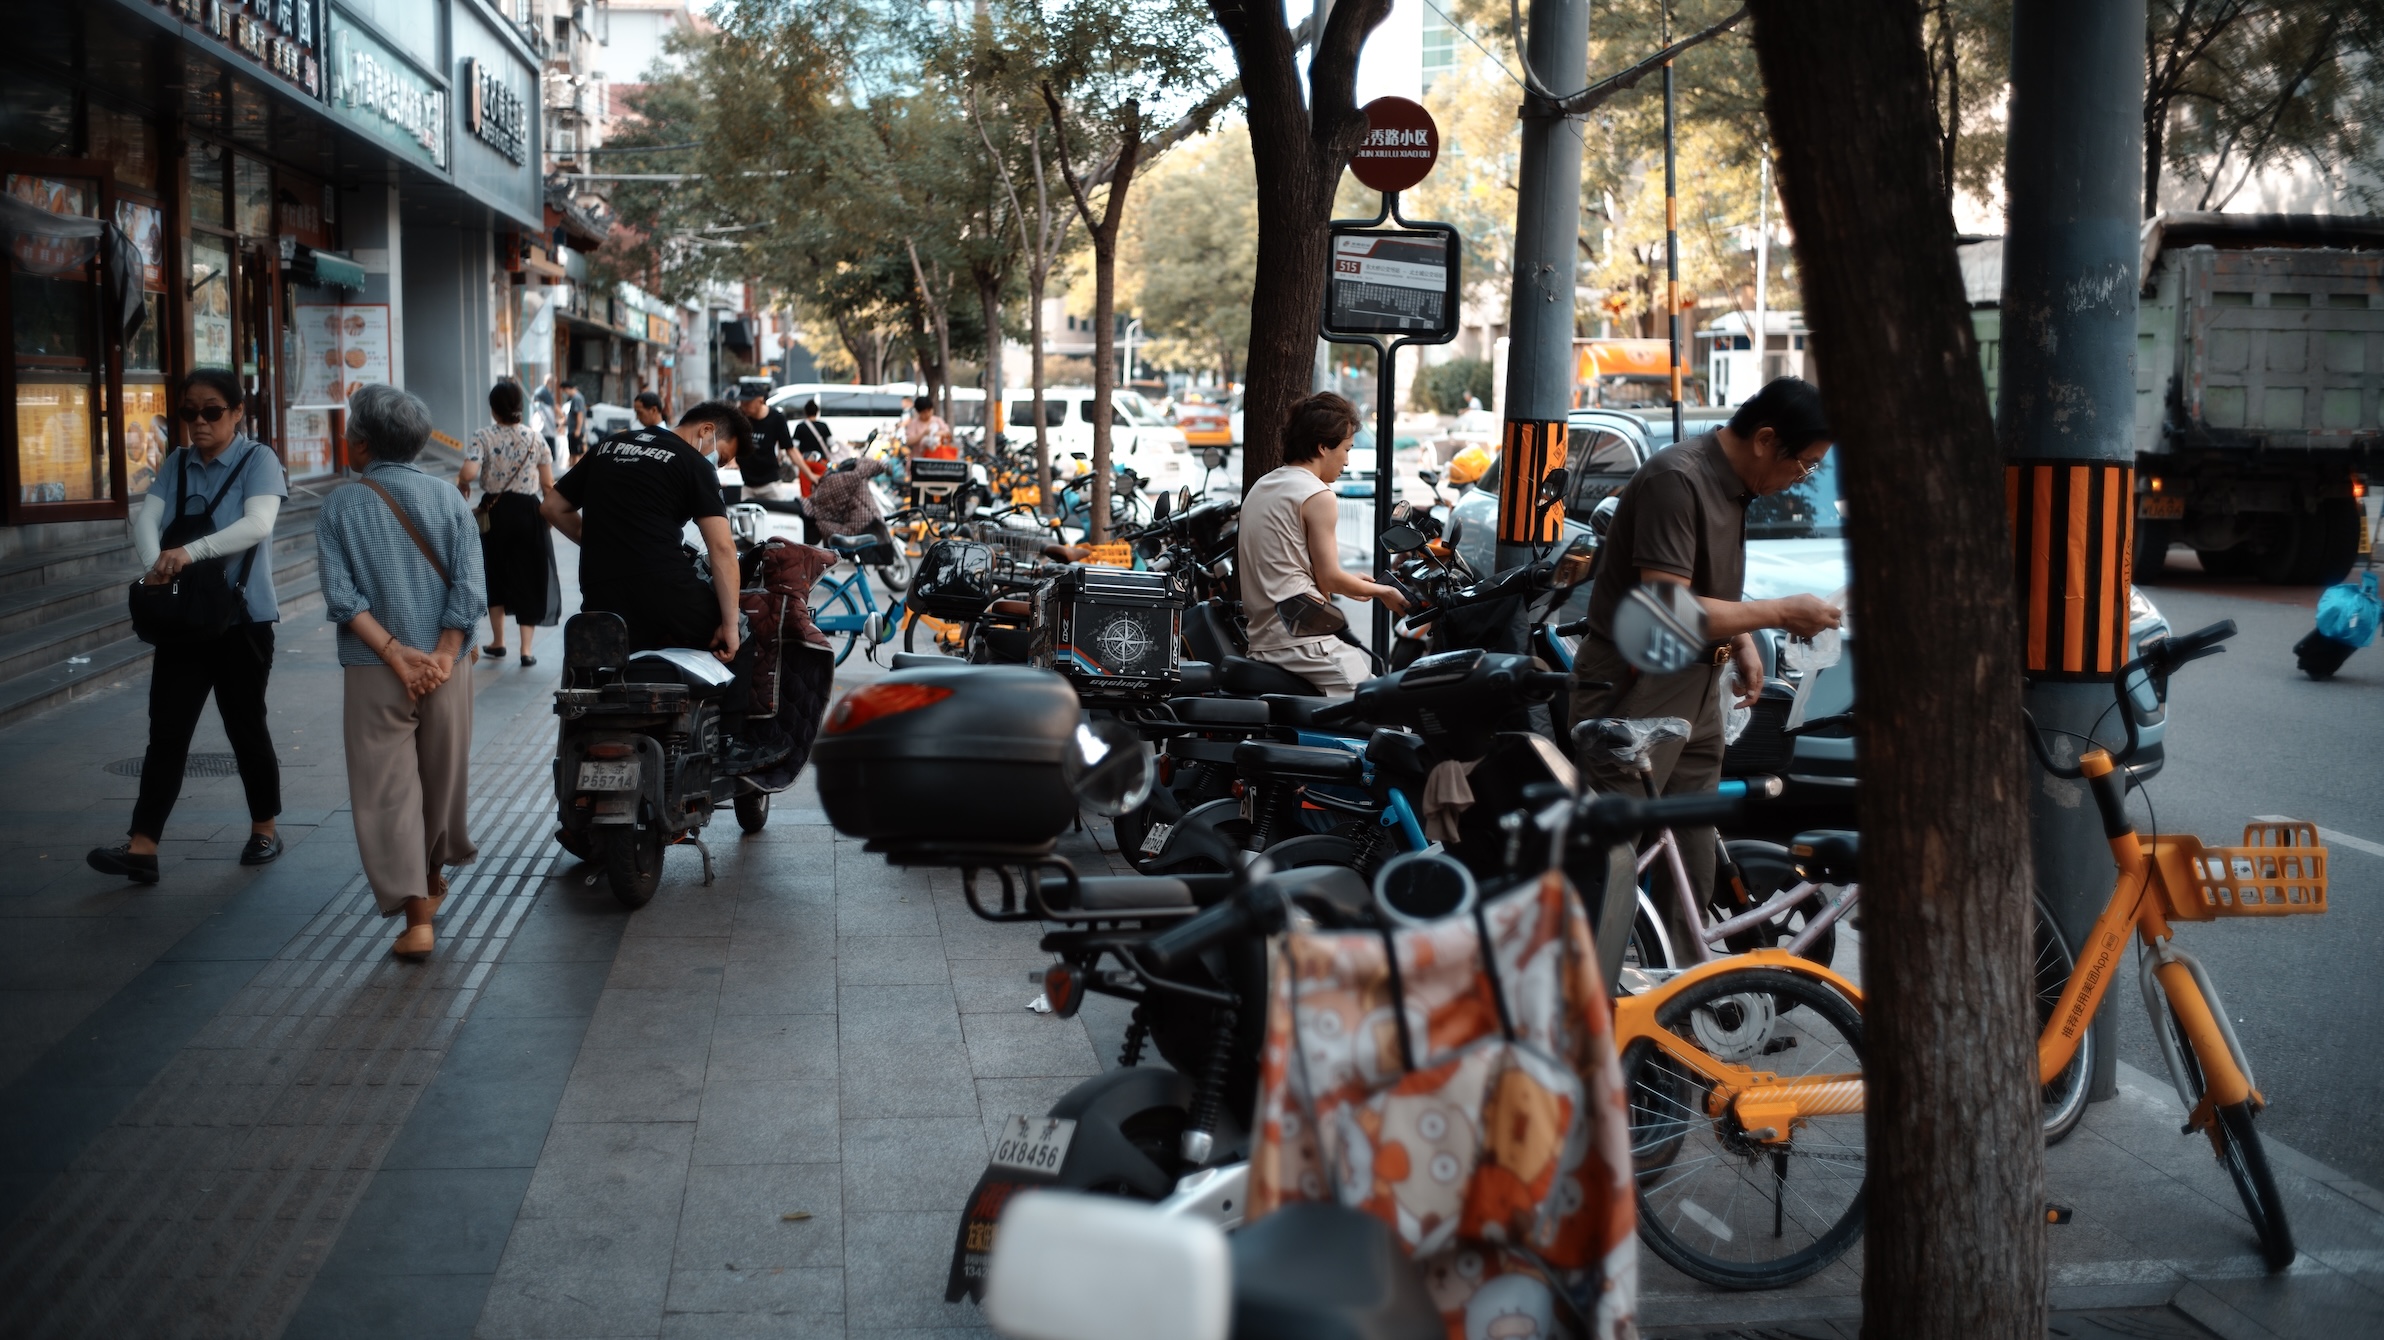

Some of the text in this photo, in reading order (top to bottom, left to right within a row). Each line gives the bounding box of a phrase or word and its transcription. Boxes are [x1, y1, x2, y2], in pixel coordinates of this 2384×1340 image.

[1361, 129, 1428, 147] 秀路小区
[1357, 150, 1374, 158] HUN
[1400, 150, 1417, 158] XIAO
[1340, 261, 1357, 272] 515
[613, 443, 676, 463] PROJECT
[581, 775, 632, 788] P55714
[2061, 951, 2110, 1038] 推荐使用美团App
[999, 1140, 1059, 1168] GX8456
